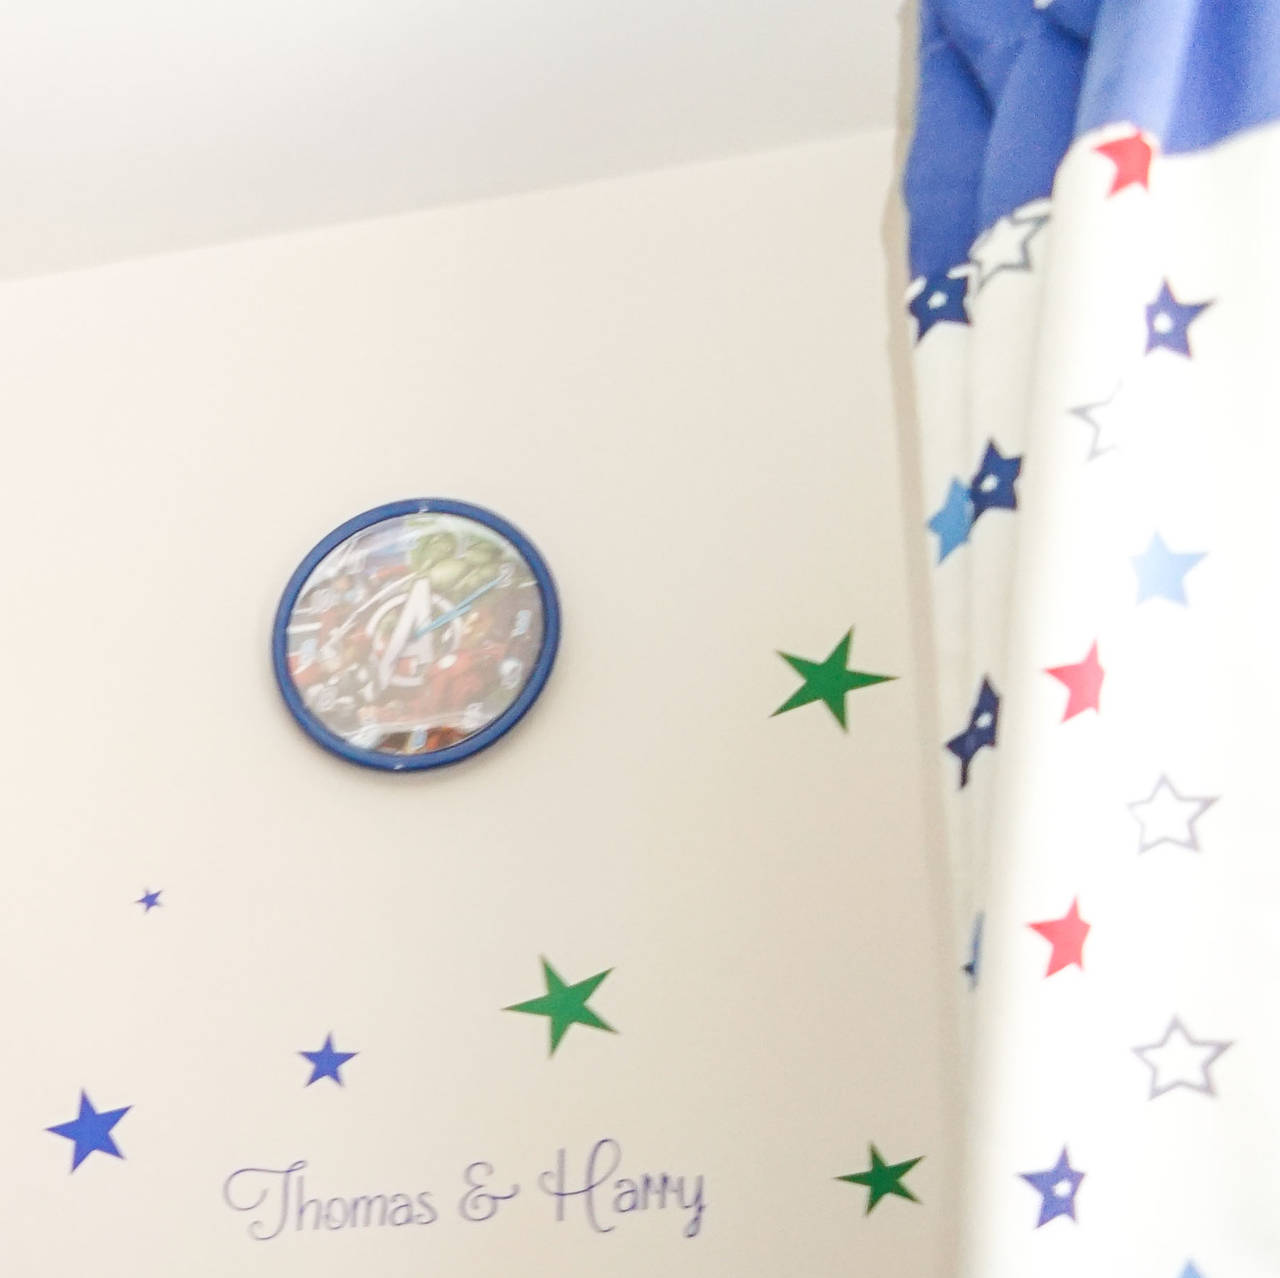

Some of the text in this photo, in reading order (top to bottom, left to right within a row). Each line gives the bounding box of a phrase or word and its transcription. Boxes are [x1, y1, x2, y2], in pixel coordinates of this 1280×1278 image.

[223, 1138, 706, 1241] Thomas & Harry
